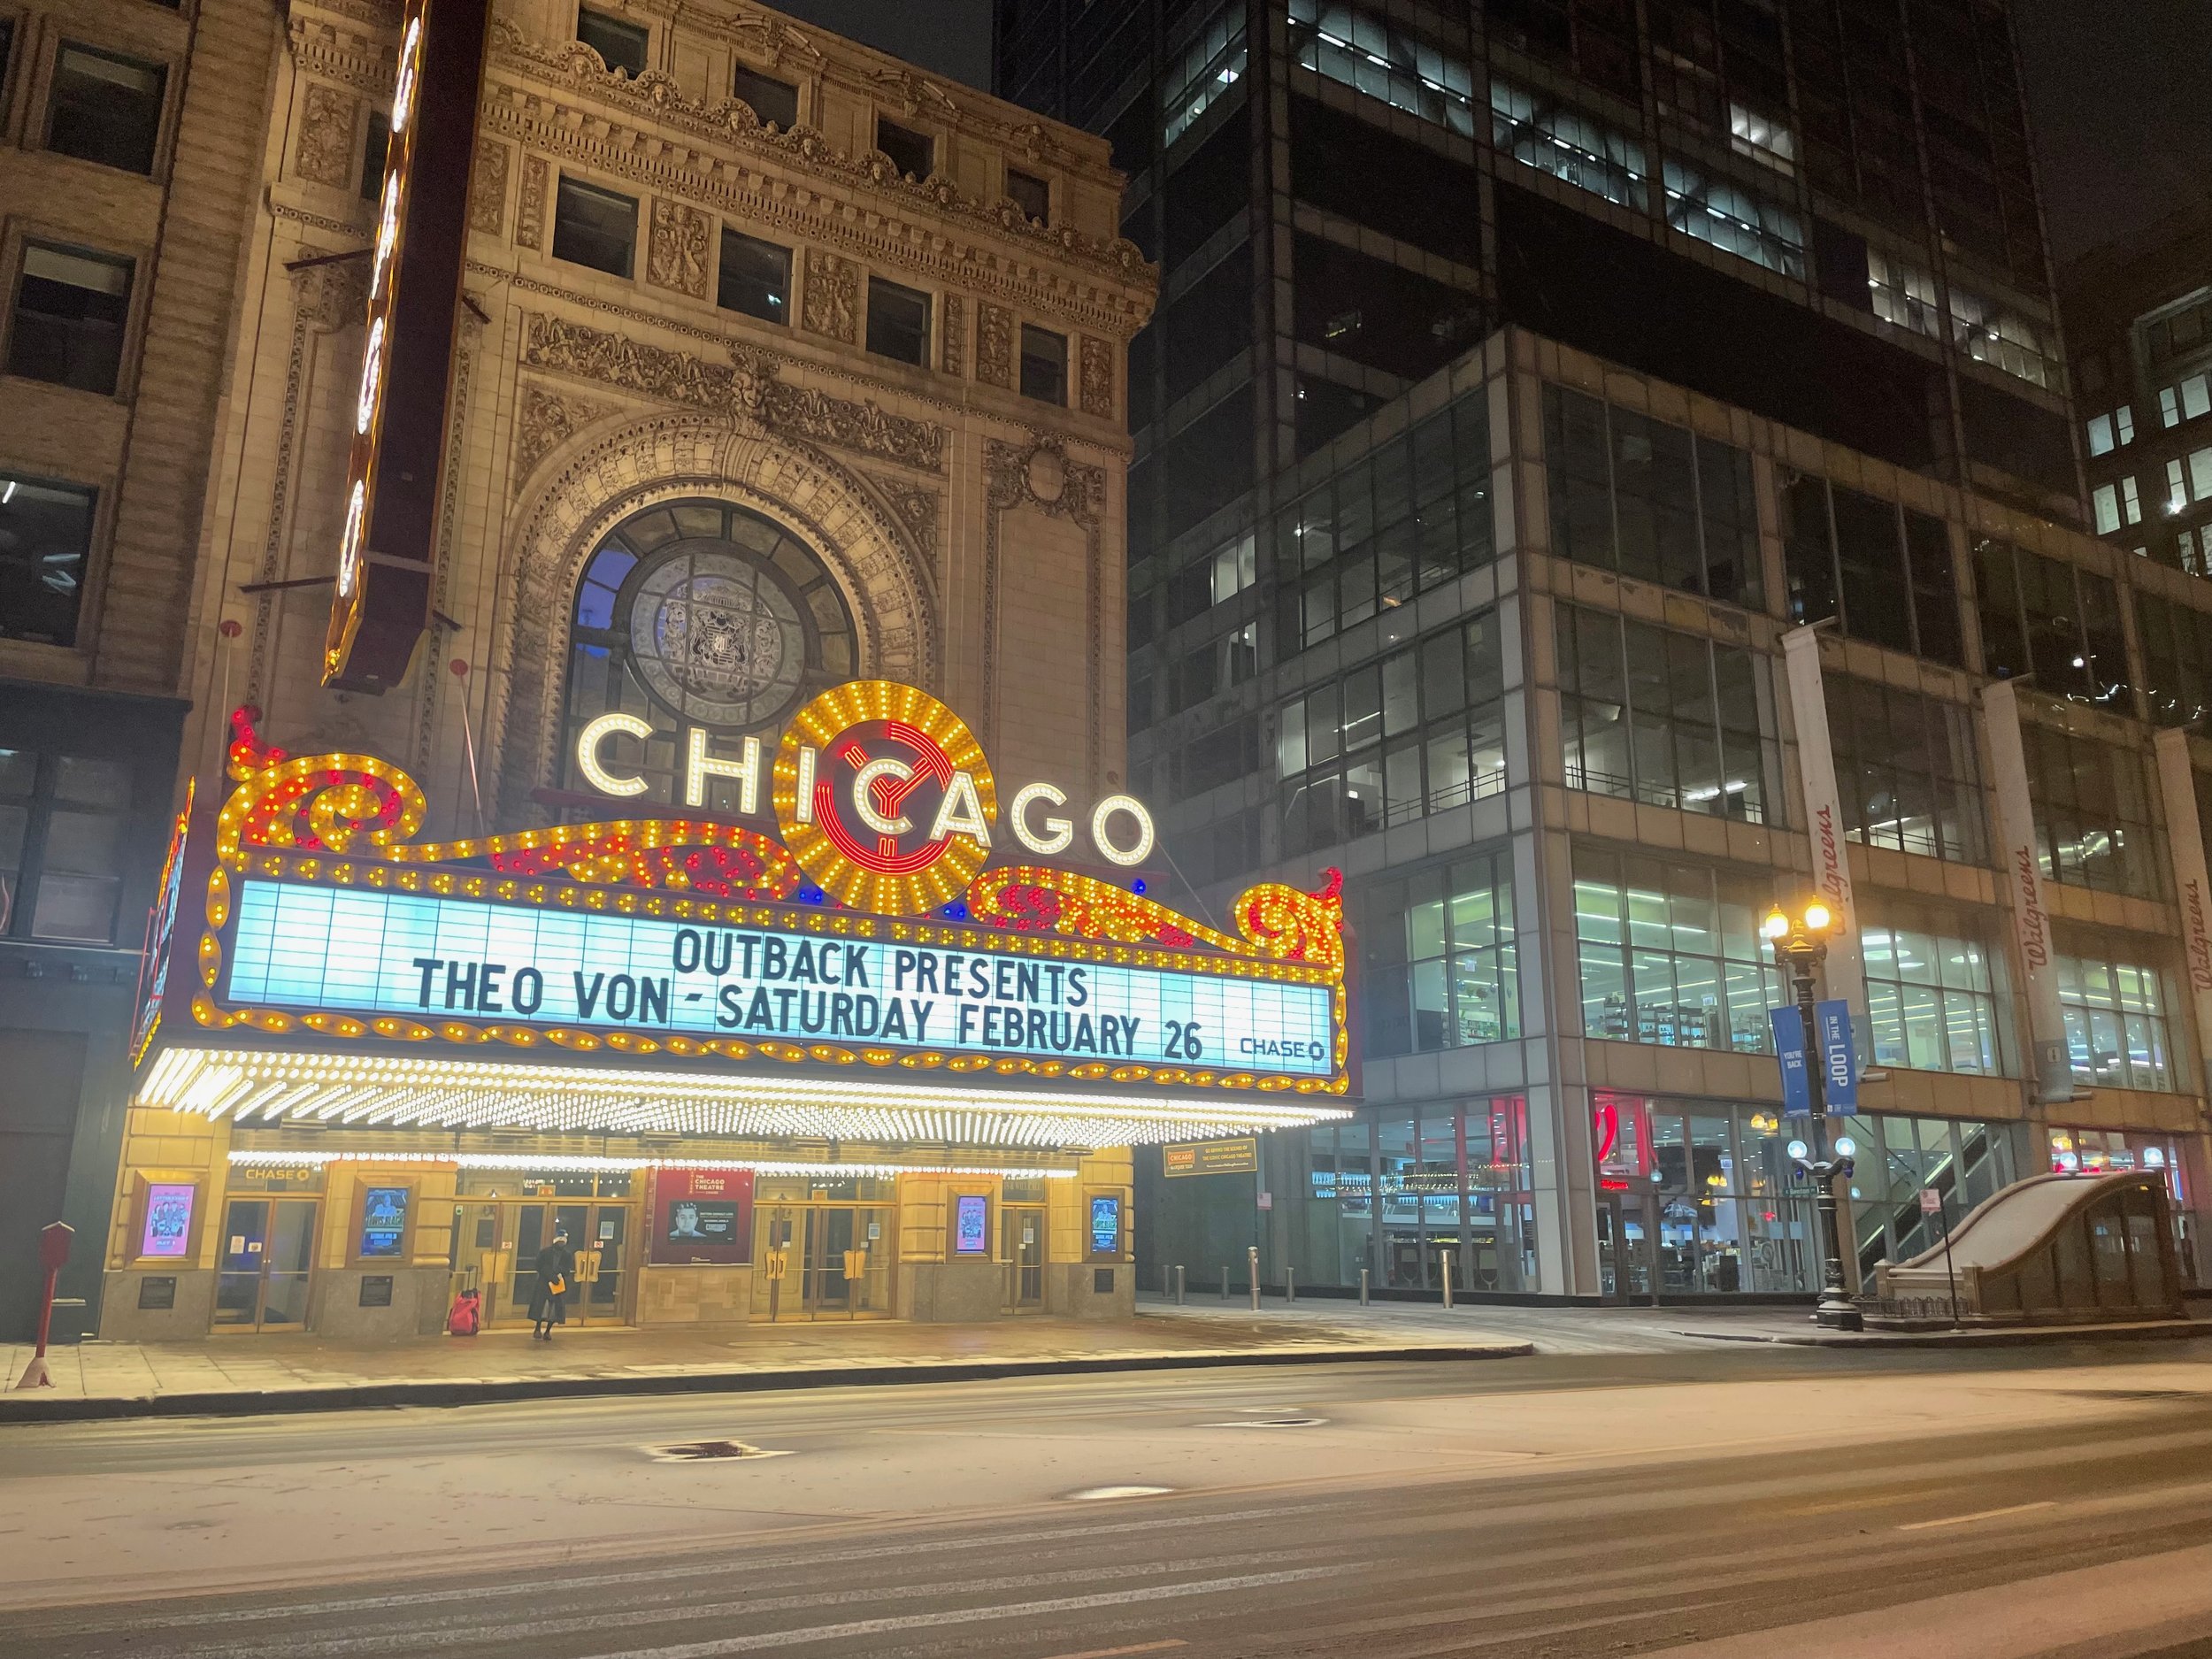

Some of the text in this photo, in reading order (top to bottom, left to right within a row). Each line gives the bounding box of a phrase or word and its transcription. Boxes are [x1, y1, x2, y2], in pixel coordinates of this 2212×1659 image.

[577, 712, 1155, 867] CHICAGO
[2015, 845, 2049, 972] Walgreens
[2185, 878, 2212, 995] Walgreens
[672, 927, 1088, 1008] OUTBACK PRESENTS
[412, 957, 544, 1016] THEO
[573, 971, 670, 1025] VON
[716, 984, 933, 1043] SATURDAY
[959, 1004, 1141, 1056] FEBRUARY
[1164, 1020, 1203, 1061] 26
[1240, 1036, 1306, 1059] CHASE
[1783, 1050, 1802, 1060] YOU'RE
[1786, 1060, 1802, 1069] BACK
[1828, 1016, 1848, 1087] IN THE LOOP
[245, 1169, 295, 1179] CHASE
